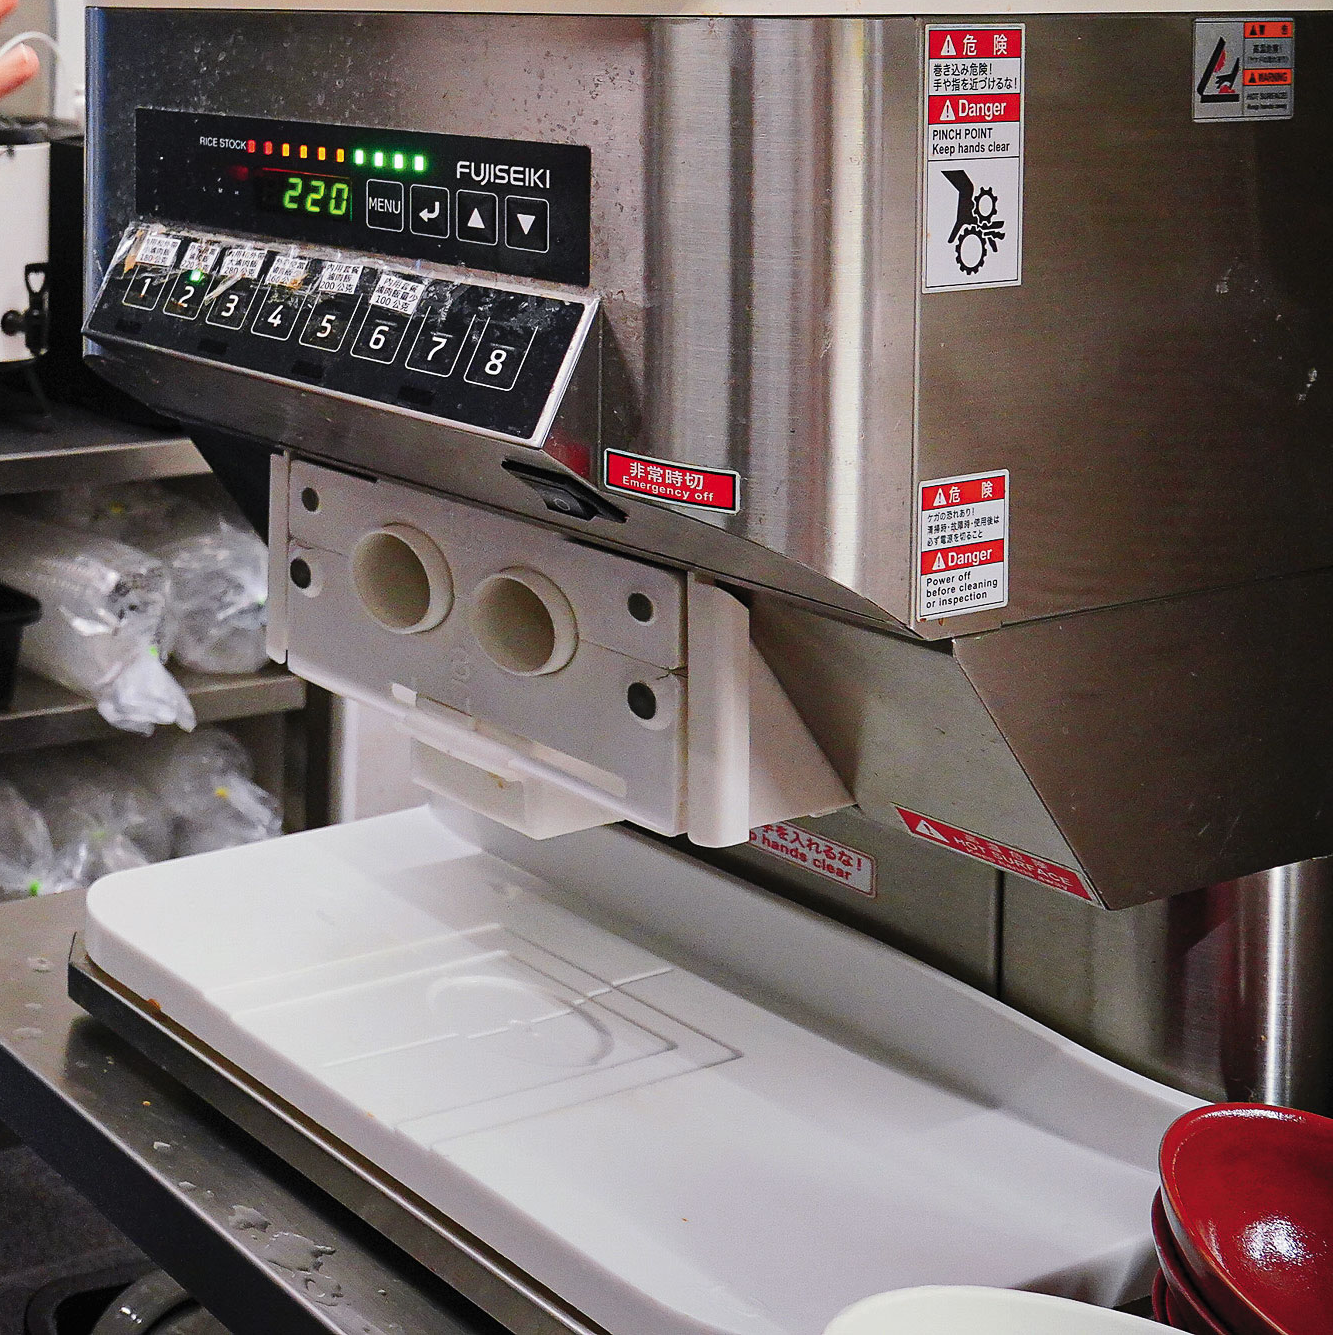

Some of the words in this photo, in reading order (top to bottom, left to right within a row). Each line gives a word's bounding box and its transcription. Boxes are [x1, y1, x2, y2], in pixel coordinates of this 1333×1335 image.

[963, 34, 1008, 55] 危険
[933, 62, 992, 77] 巻き込み危険!
[933, 77, 1017, 92] 手や指を近づけるな!
[958, 99, 1006, 120] Danger
[200, 136, 218, 148] RICE
[219, 138, 247, 150] STOCK
[933, 129, 962, 140] PINCH
[964, 128, 993, 139] POINT
[932, 143, 955, 156] Keep
[958, 142, 985, 154] hands
[988, 141, 1010, 152] clear
[457, 160, 550, 188] FUJISEIKI
[283, 177, 349, 216] 220
[368, 196, 402, 215] MENU
[140, 278, 151, 297] 1
[319, 281, 335, 290] 200
[179, 286, 194, 308] 2
[221, 294, 238, 317] 3
[375, 295, 391, 306] 100
[393, 299, 410, 311] 公克
[267, 305, 283, 327] 4
[317, 315, 336, 338] 5
[369, 325, 389, 350] 6
[429, 337, 446, 361] 7
[484, 349, 506, 375] 8
[629, 461, 704, 490] 非常時切
[622, 476, 690, 499] Emergency
[695, 491, 714, 502] off
[949, 481, 993, 503] 危険
[948, 549, 993, 566] Danger
[926, 574, 955, 587] Power
[958, 571, 971, 582] off
[926, 585, 956, 598] before
[959, 578, 998, 592] cleaning
[926, 600, 936, 609] or
[939, 591, 987, 606] inspection
[762, 834, 808, 863] hands
[813, 858, 852, 880] clear
[953, 836, 986, 854] HOT
[991, 851, 1074, 887] SURFACE
